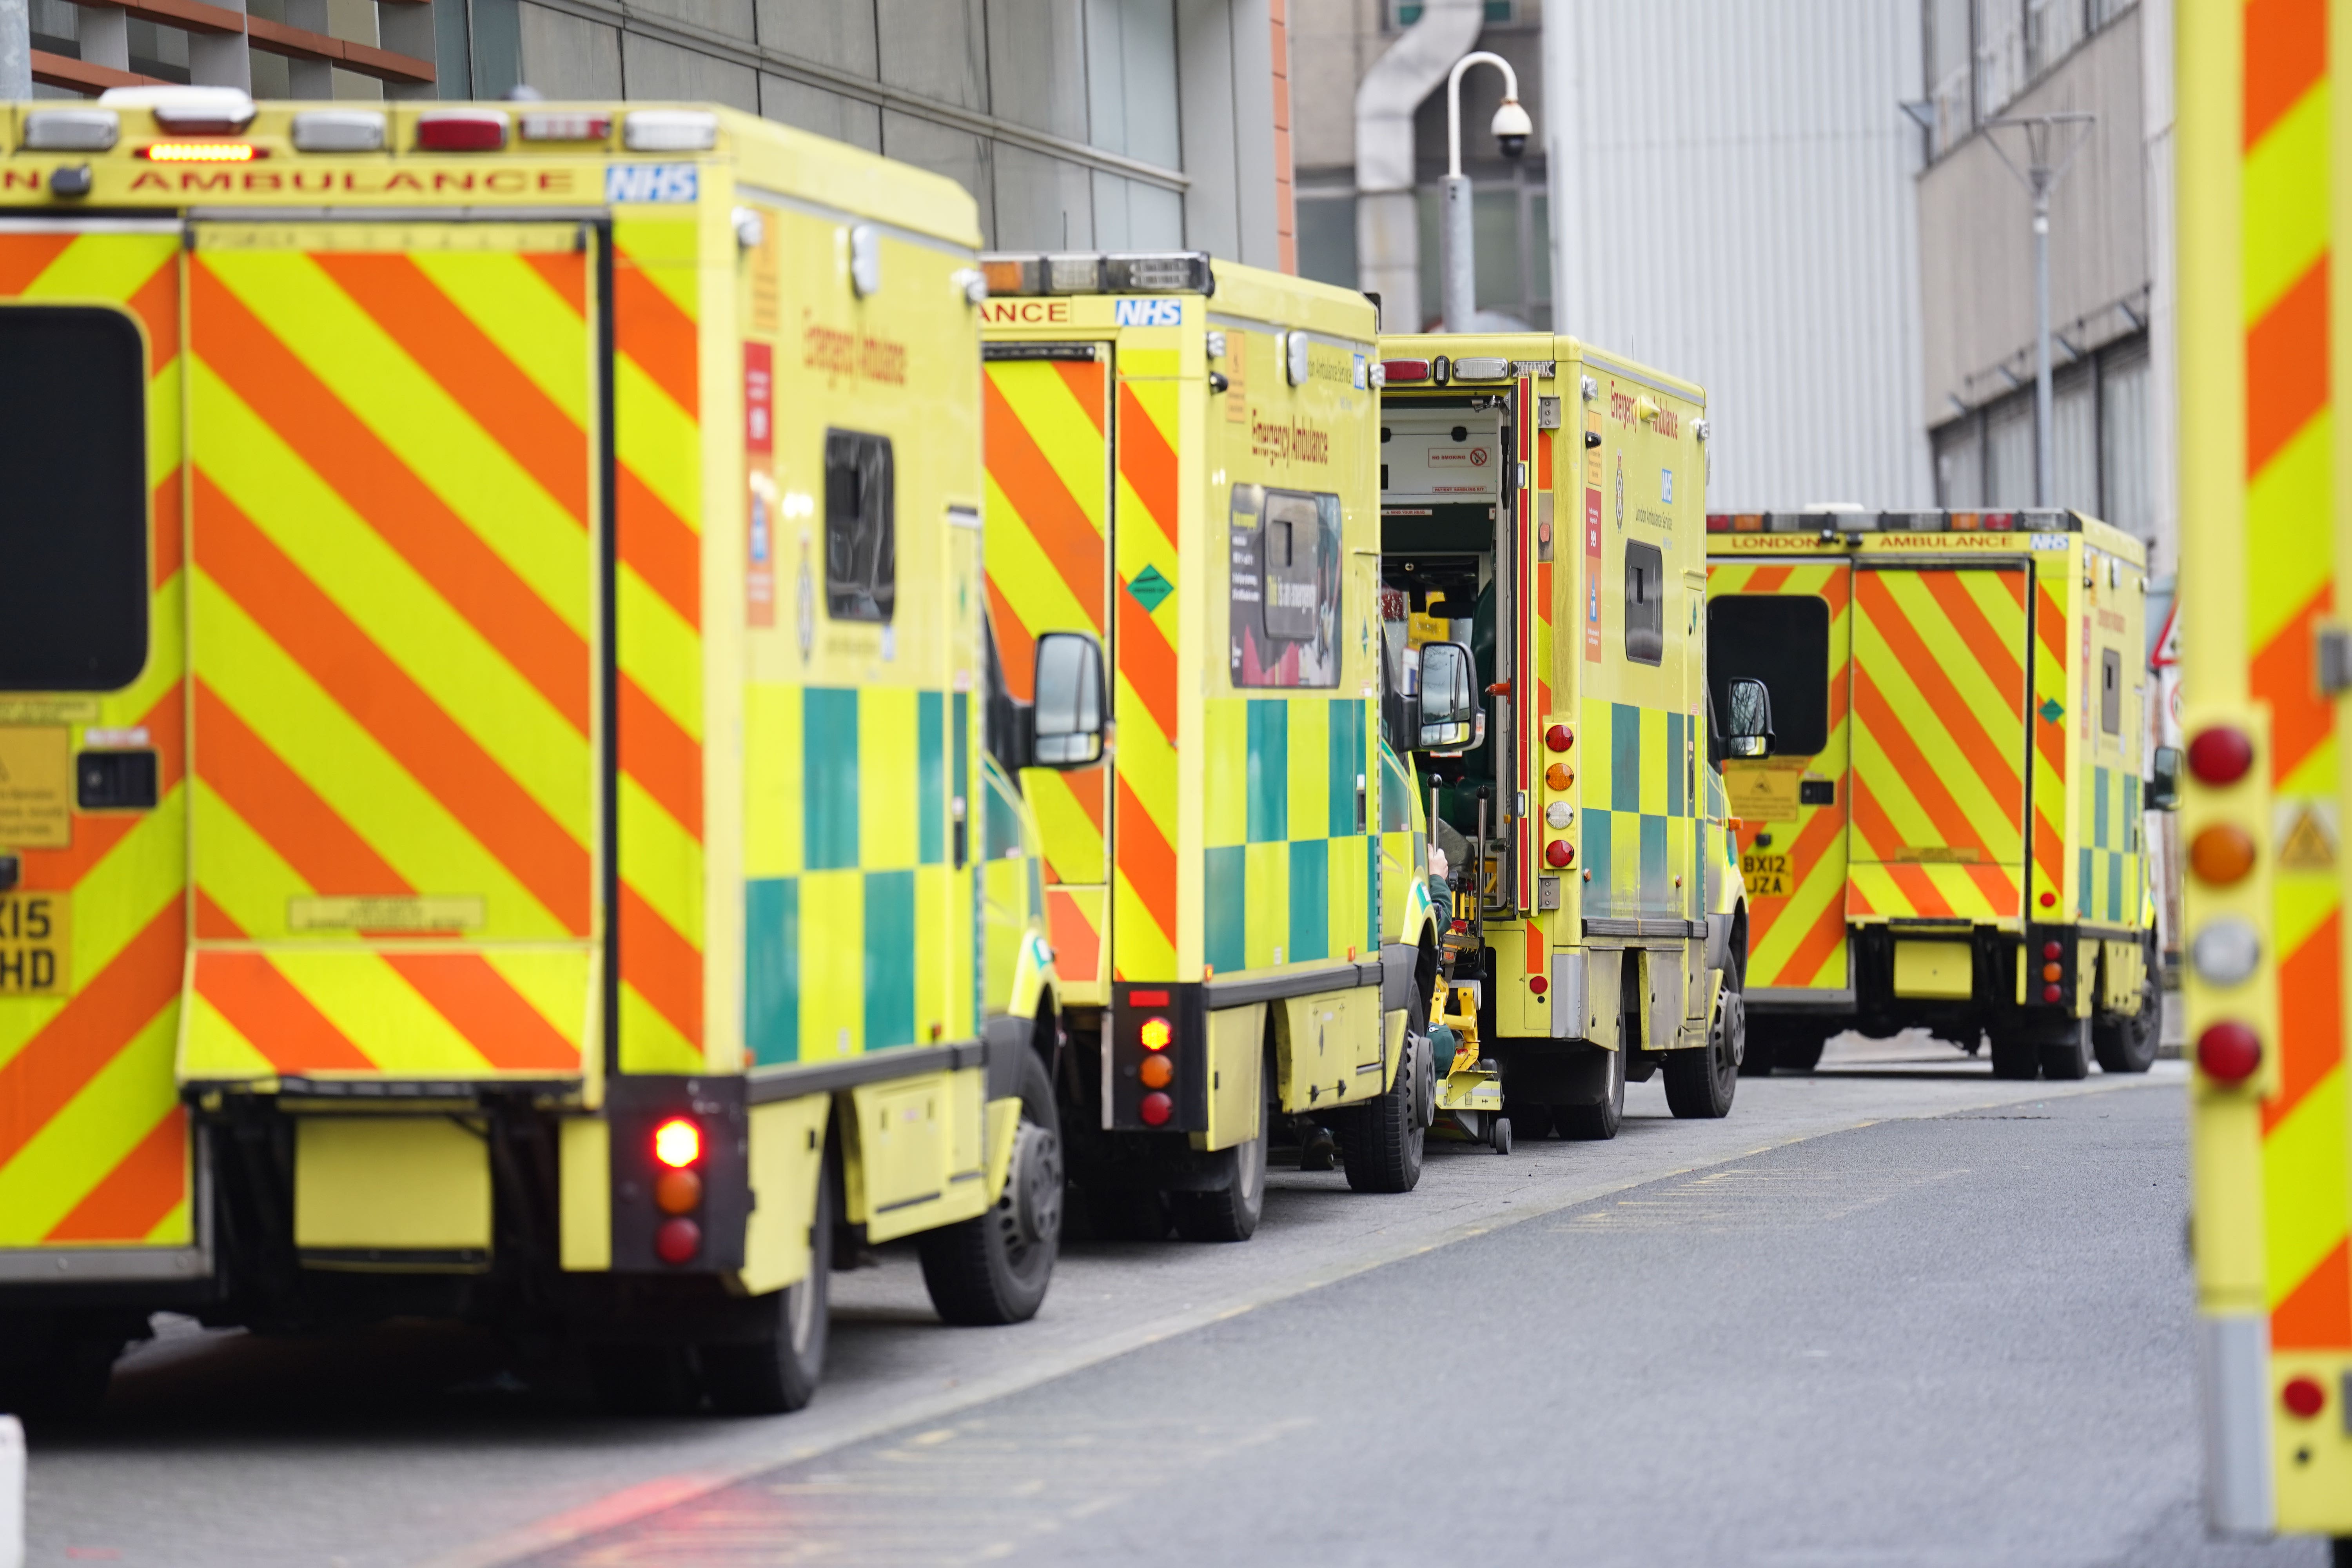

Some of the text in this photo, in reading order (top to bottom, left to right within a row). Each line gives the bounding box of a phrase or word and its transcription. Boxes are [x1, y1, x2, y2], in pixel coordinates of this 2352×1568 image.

[129, 169, 575, 193] AMBULANCE
[608, 164, 697, 202] NHS
[1116, 298, 1181, 326] NHS
[1611, 379, 1637, 434] Emergency
[1252, 408, 1328, 468] Emergency Ambulance
[1662, 470, 1672, 503] NHS
[1635, 503, 1672, 531] London Ambulance Service
[1732, 535, 2012, 548] LONDON AMBULANCE
[2031, 532, 2069, 550] NHS
[1743, 856, 1786, 873] BX12
[1746, 877, 1782, 894] JZA
[0, 900, 50, 938] 15
[0, 949, 54, 988] HD
